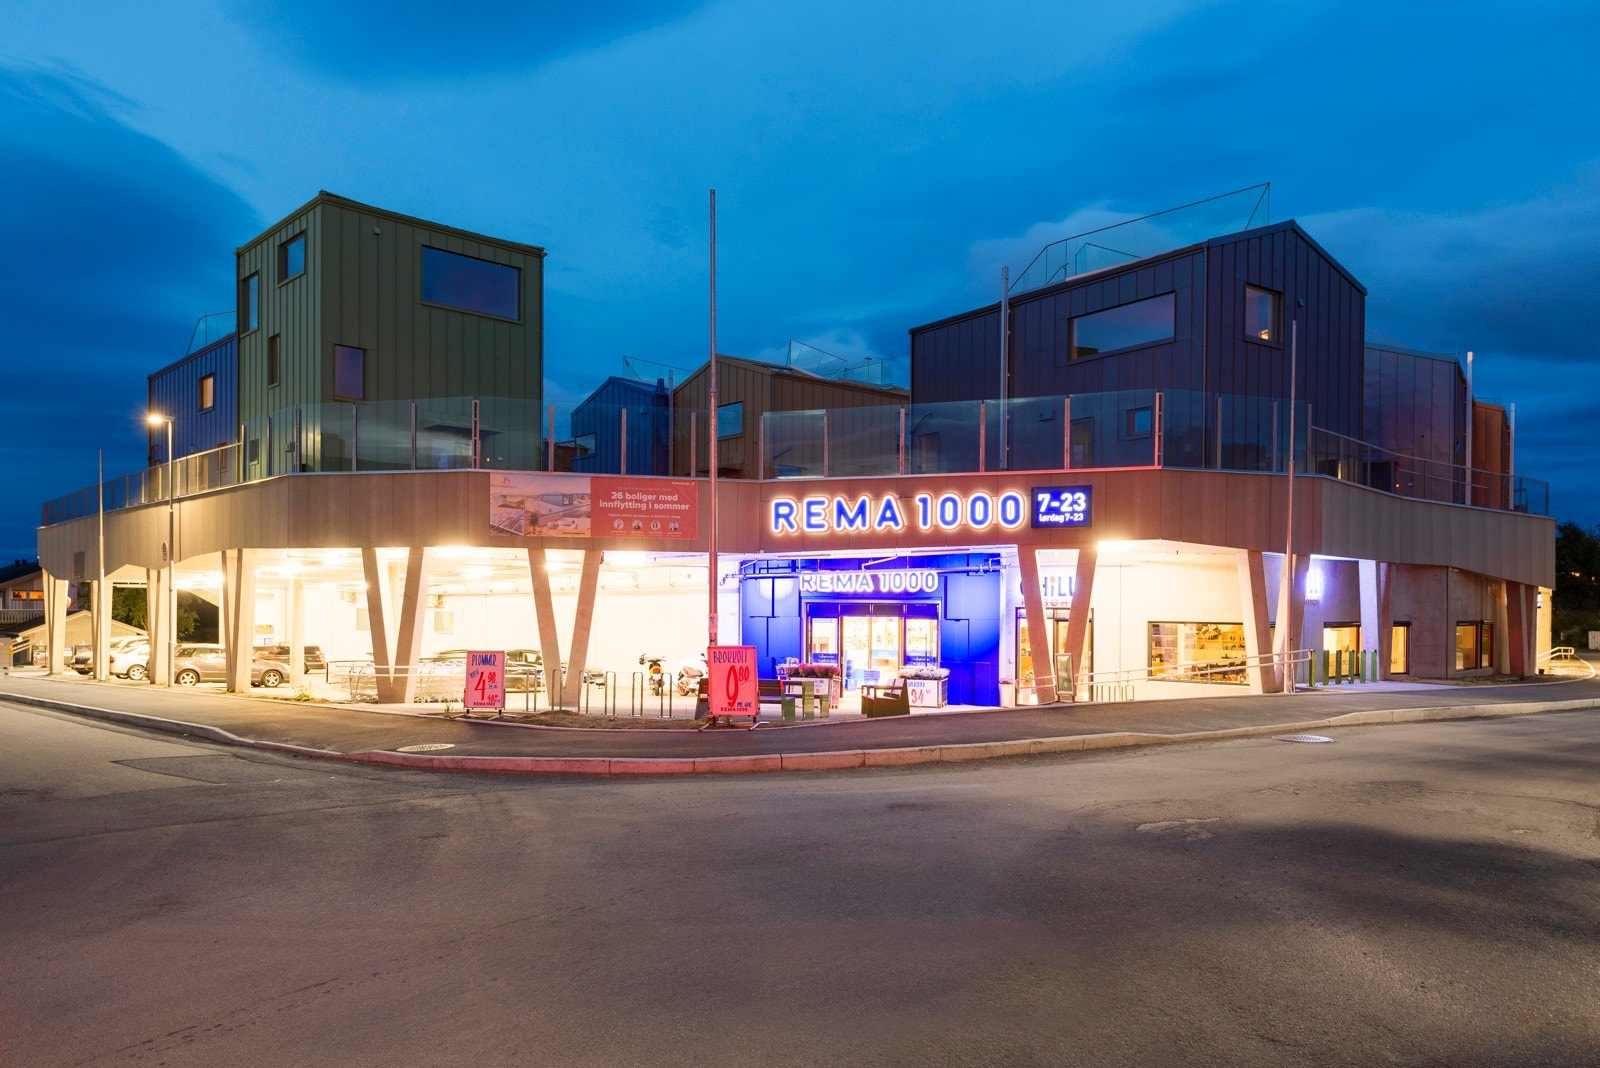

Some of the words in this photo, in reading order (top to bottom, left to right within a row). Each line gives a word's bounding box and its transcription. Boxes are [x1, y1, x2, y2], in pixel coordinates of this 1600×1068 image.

[599, 499, 647, 511] innflytting
[649, 500, 652, 509] i
[653, 502, 690, 511] sommer
[611, 491, 624, 500] 26
[625, 492, 652, 502] boliger
[659, 493, 679, 502] med
[1037, 492, 1087, 513] 7-23
[770, 495, 904, 532] REMA
[914, 490, 1026, 531] 1000
[1065, 512, 1084, 522] 7-23
[799, 571, 875, 593] REMA
[878, 570, 939, 593] 1000
[474, 671, 486, 701] 4
[726, 665, 739, 707] 9
